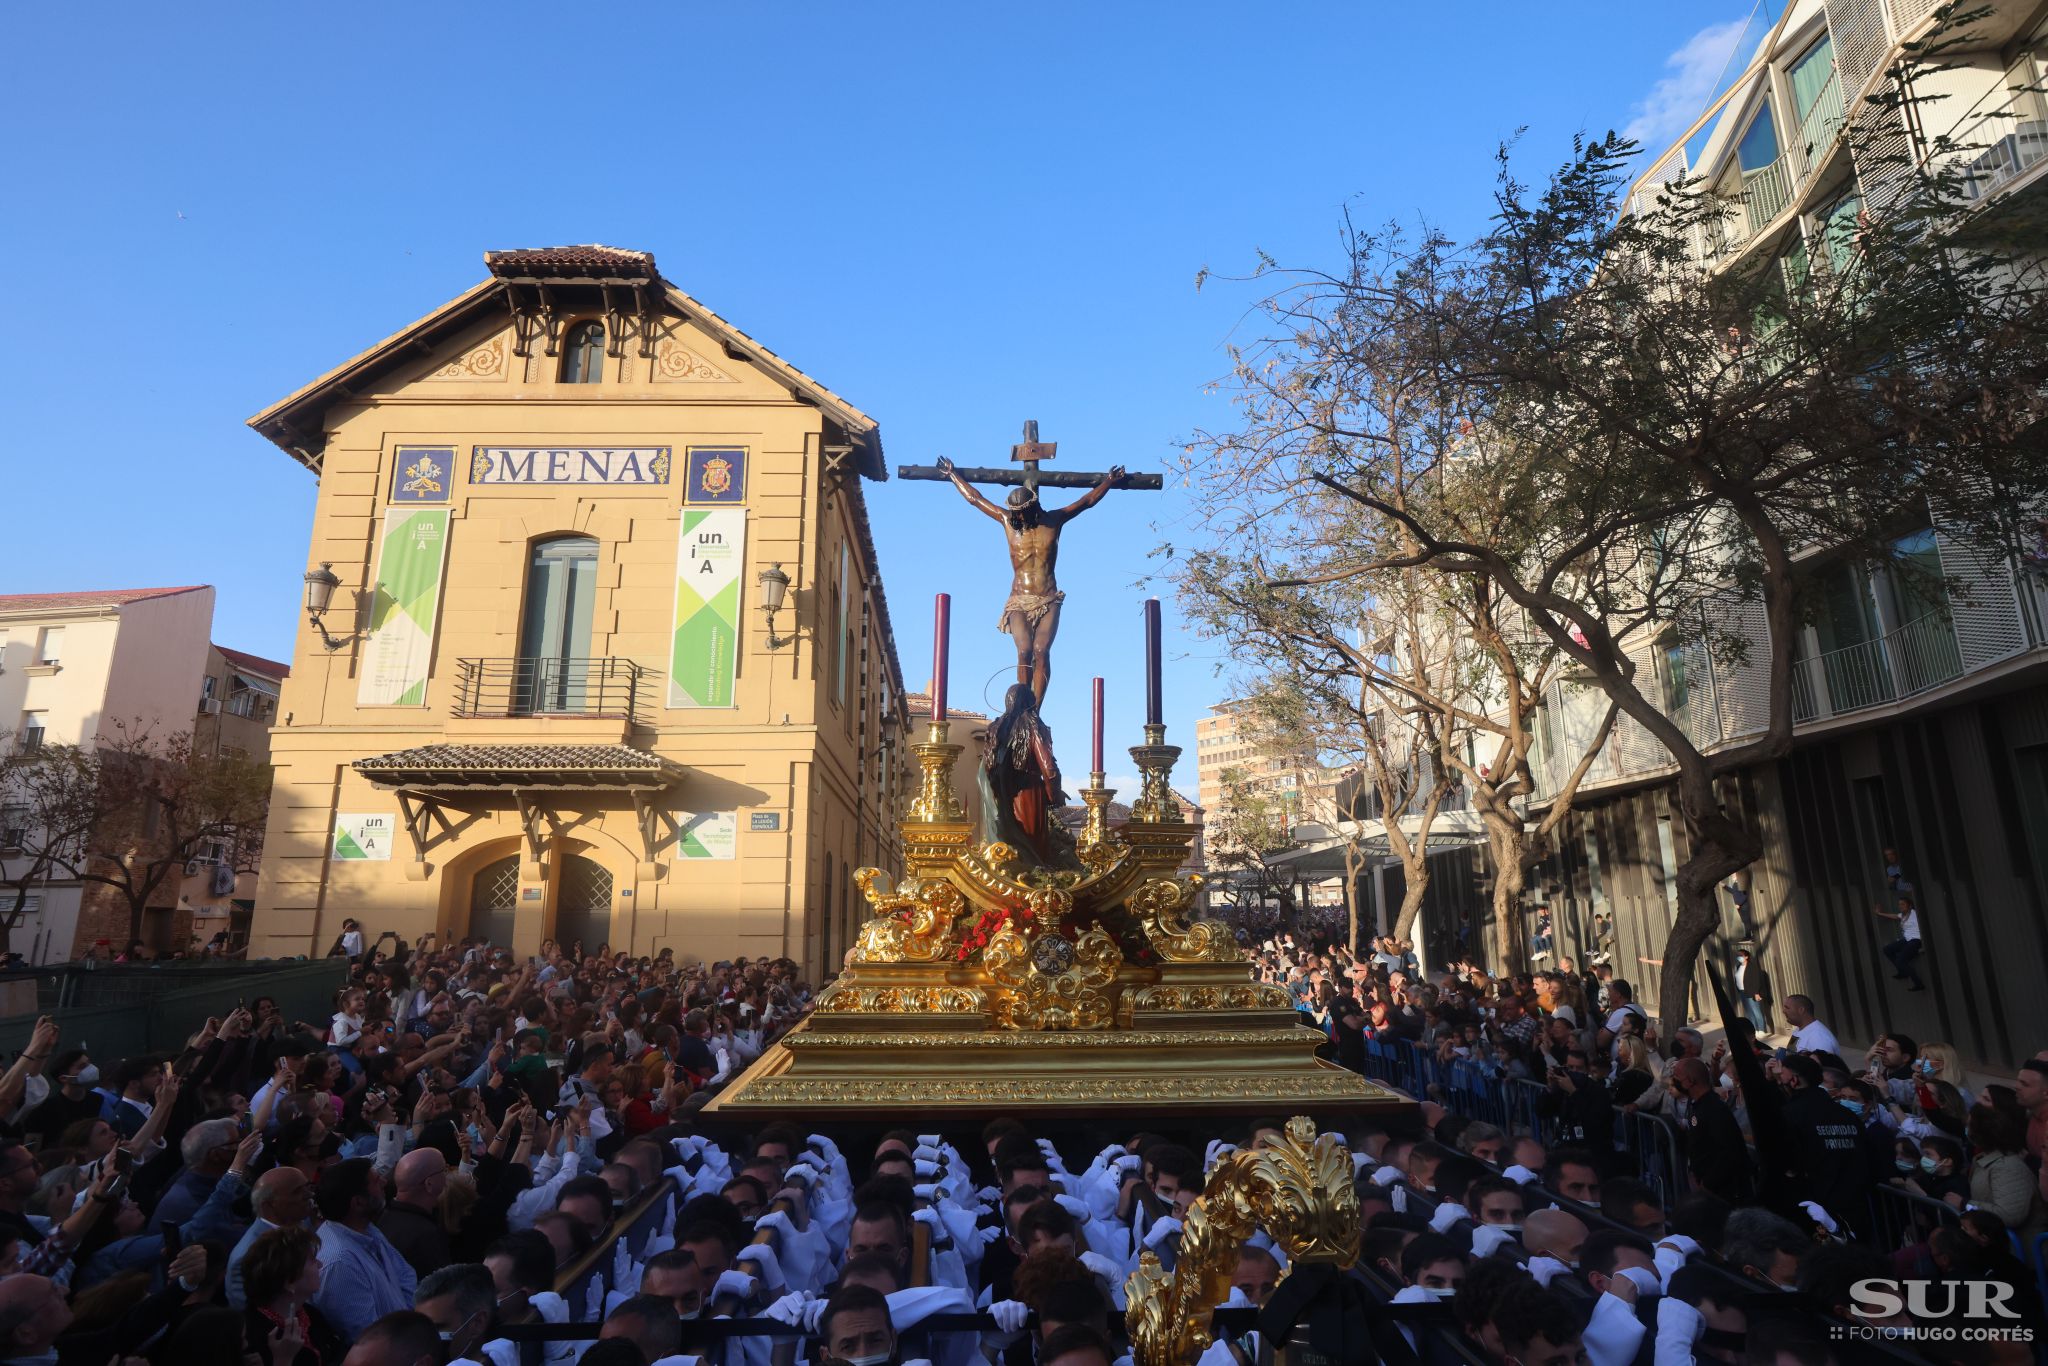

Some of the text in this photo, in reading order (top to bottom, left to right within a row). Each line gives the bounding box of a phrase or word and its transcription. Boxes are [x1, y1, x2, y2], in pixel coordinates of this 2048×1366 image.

[496, 450, 646, 482] MENA
[699, 533, 722, 544] un
[699, 559, 713, 574] A
[366, 818, 383, 827] un
[365, 838, 375, 849] A
